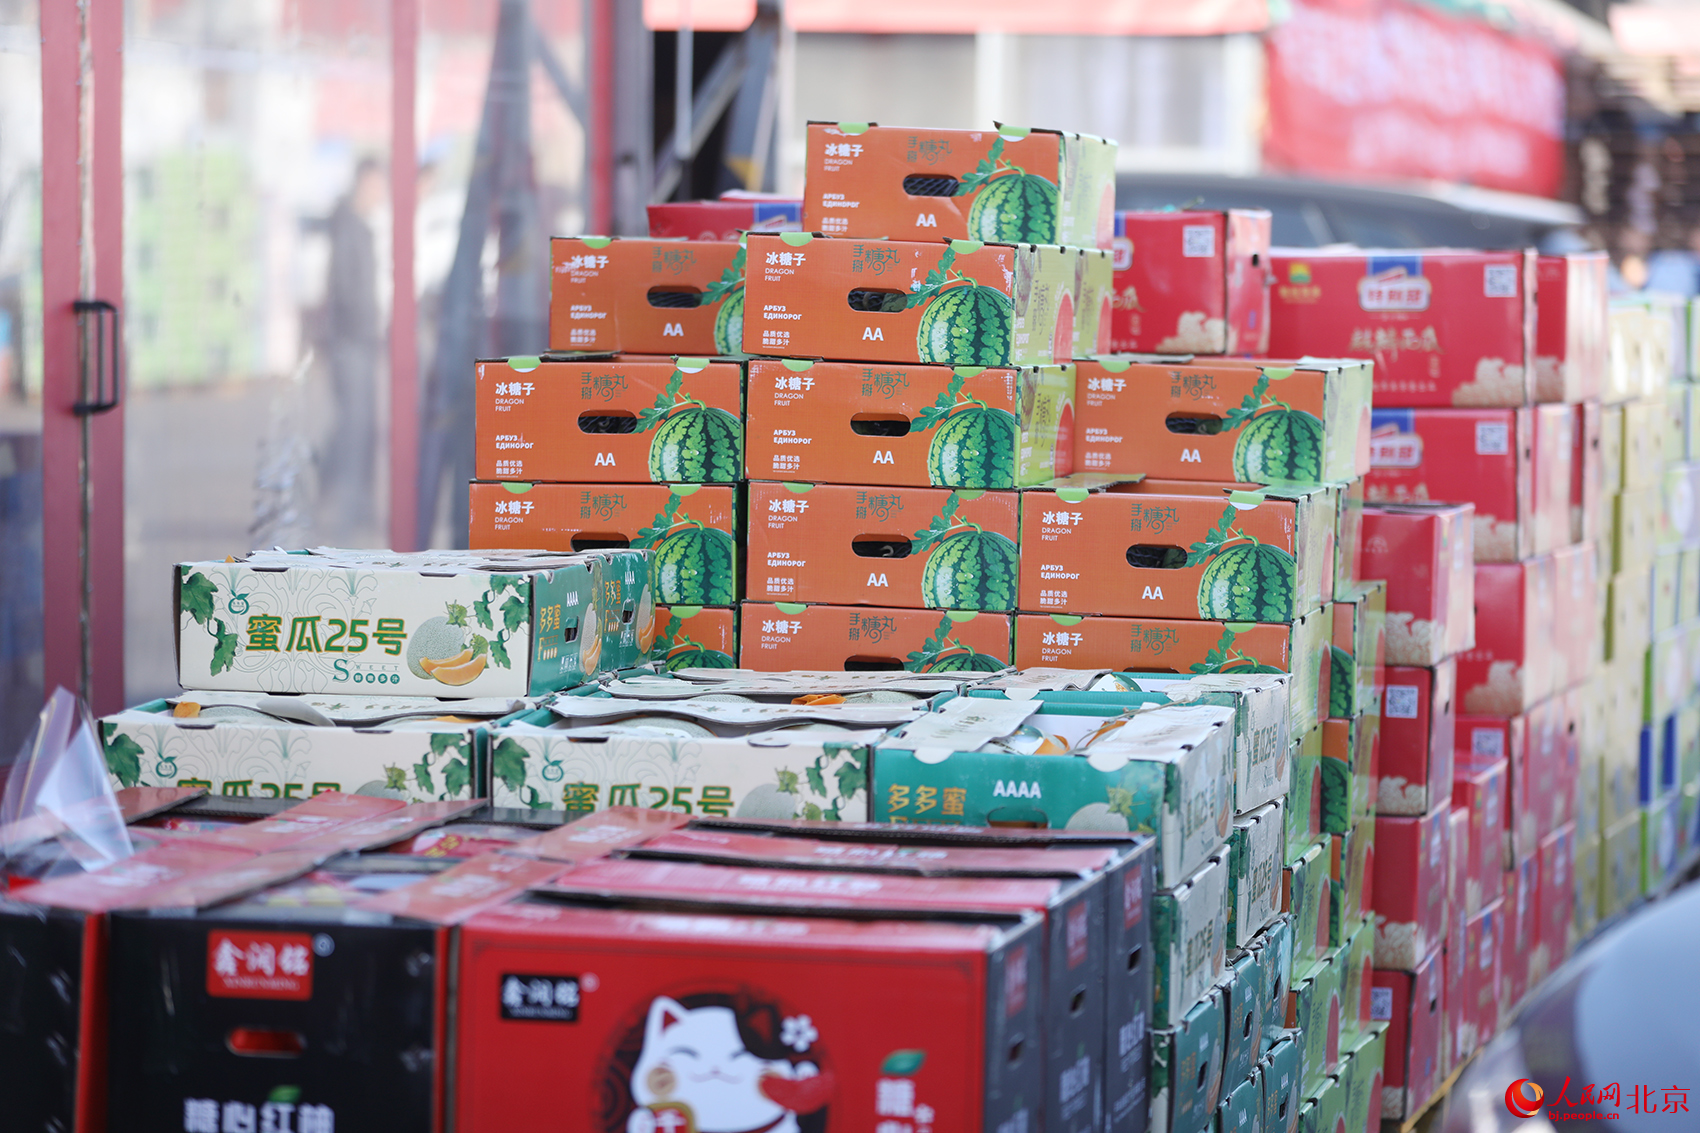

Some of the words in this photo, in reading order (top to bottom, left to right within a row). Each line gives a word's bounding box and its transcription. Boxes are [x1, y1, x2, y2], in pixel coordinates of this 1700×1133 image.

[825, 143, 863, 157] 冰糖子
[916, 214, 937, 227] AA
[571, 255, 609, 268] 冰糖子
[766, 252, 806, 266] 冰糖子
[663, 323, 683, 336] AA
[763, 330, 790, 338] 品质优选
[862, 327, 884, 341] AA
[763, 338, 789, 346] 脆甜多汁
[495, 382, 535, 395] 冰糖子
[775, 377, 815, 390] 冰糖子
[1088, 378, 1126, 392] 冰糖子
[595, 453, 616, 466] AA
[873, 451, 894, 464] AA
[1181, 449, 1201, 462] AA
[496, 466, 522, 474] 脆甜多汁
[495, 501, 534, 514] 冰糖子
[769, 499, 809, 513] 冰糖子
[1042, 511, 1083, 525] 冰糖子
[767, 577, 794, 585] 品质优选
[867, 573, 888, 587] AA
[1041, 572, 1080, 580] ЕДИНОРОГ
[1040, 590, 1067, 598] 品质优选
[1142, 586, 1163, 600] AA
[762, 620, 802, 634] 冰糖子
[245, 613, 408, 656] 蜜瓜25号
[1043, 632, 1083, 646] 冰糖子
[993, 779, 1042, 799] AAAA
[888, 784, 967, 816] 多多蜜
